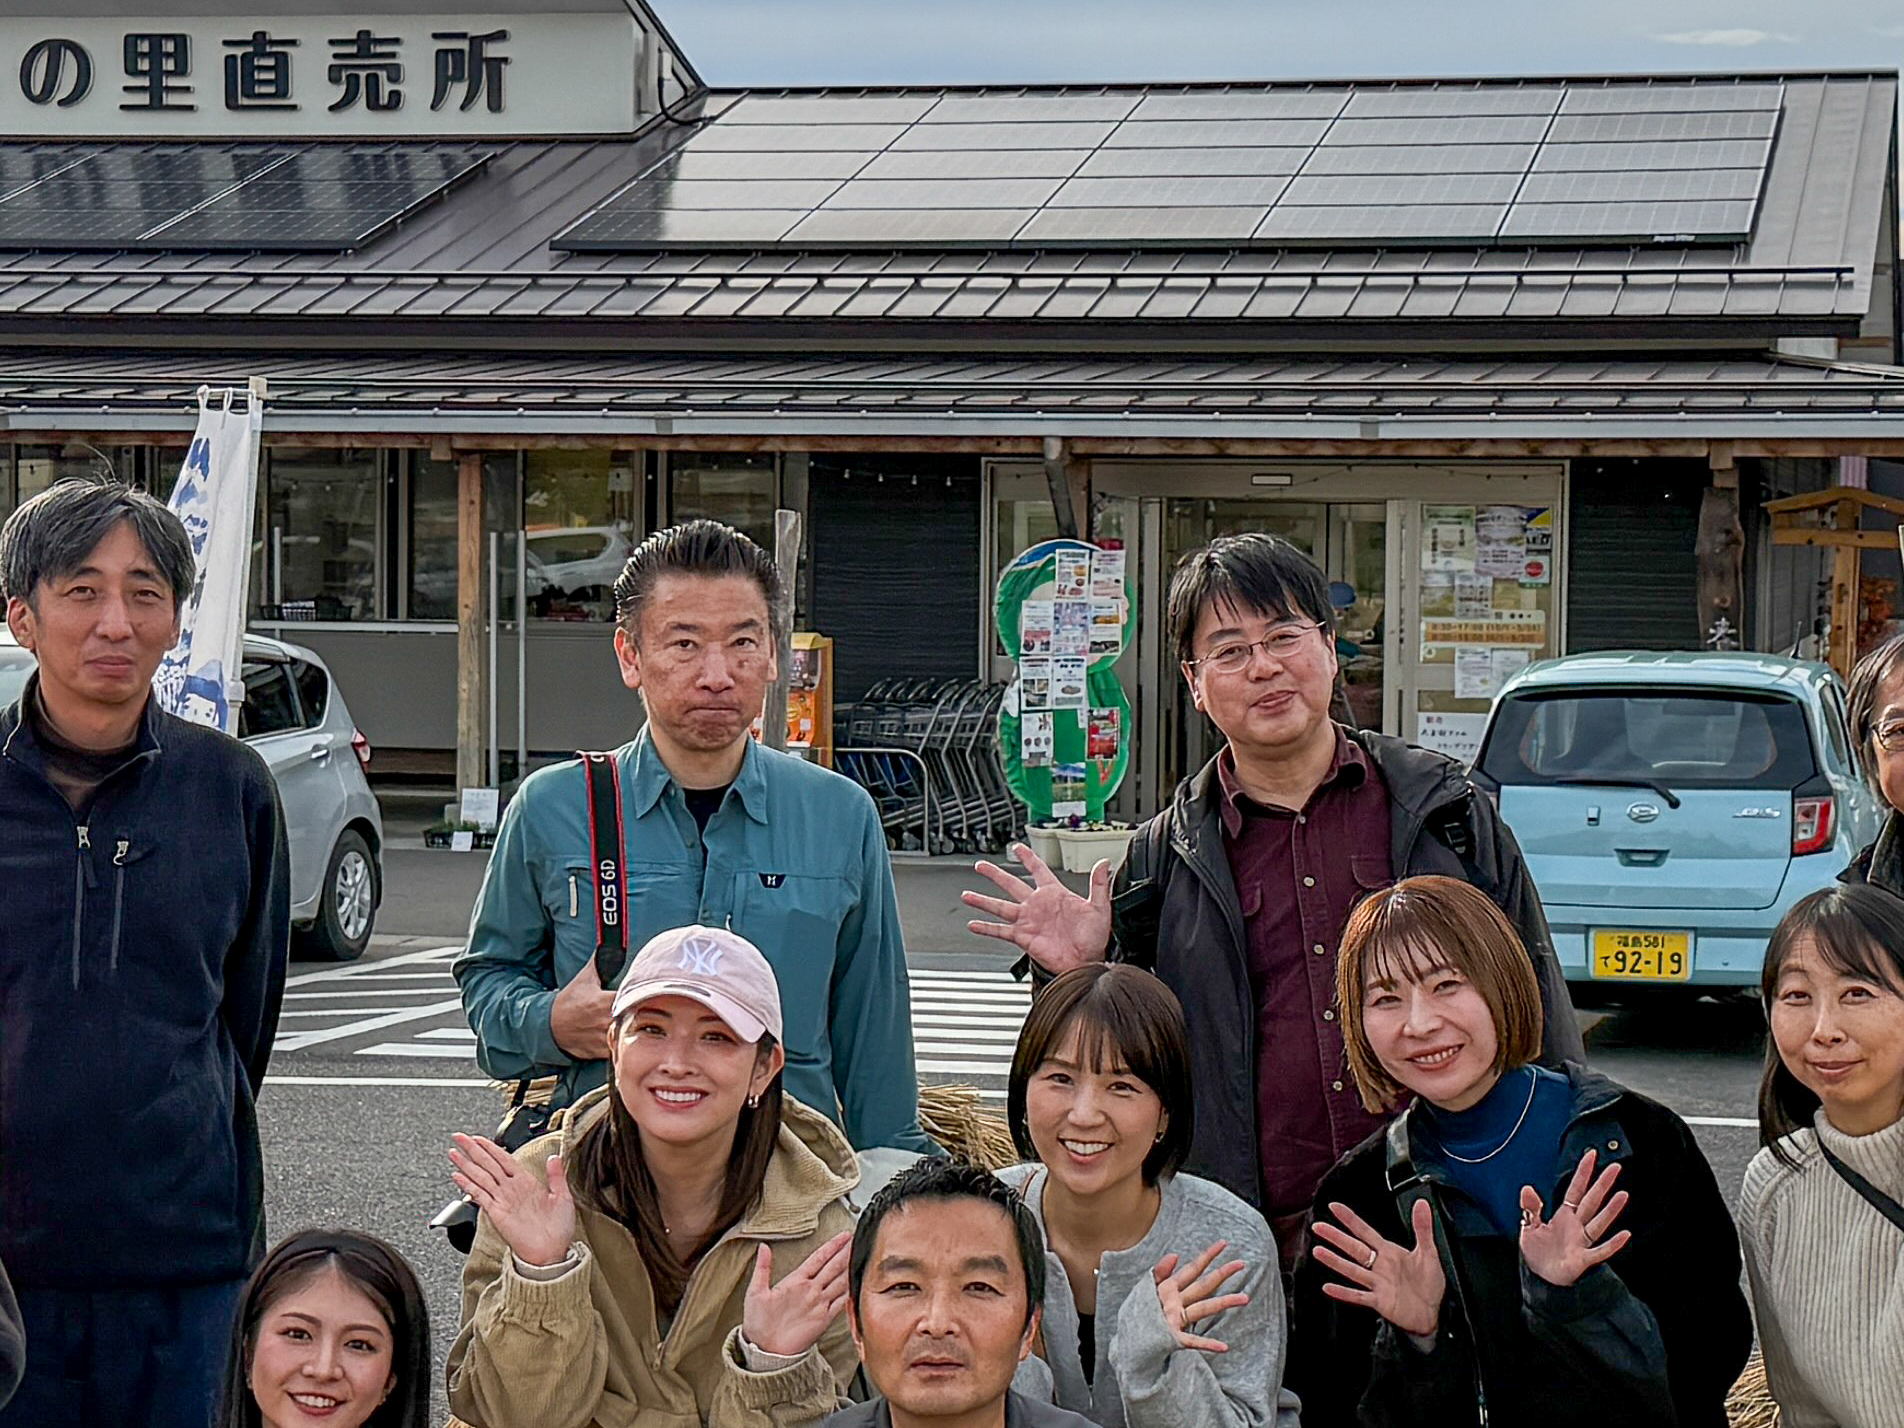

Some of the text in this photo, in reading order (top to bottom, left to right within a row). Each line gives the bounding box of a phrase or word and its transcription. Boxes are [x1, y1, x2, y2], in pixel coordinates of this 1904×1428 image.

[599, 858, 617, 925] EOS 6D
[1613, 949, 1683, 975] 92-19
